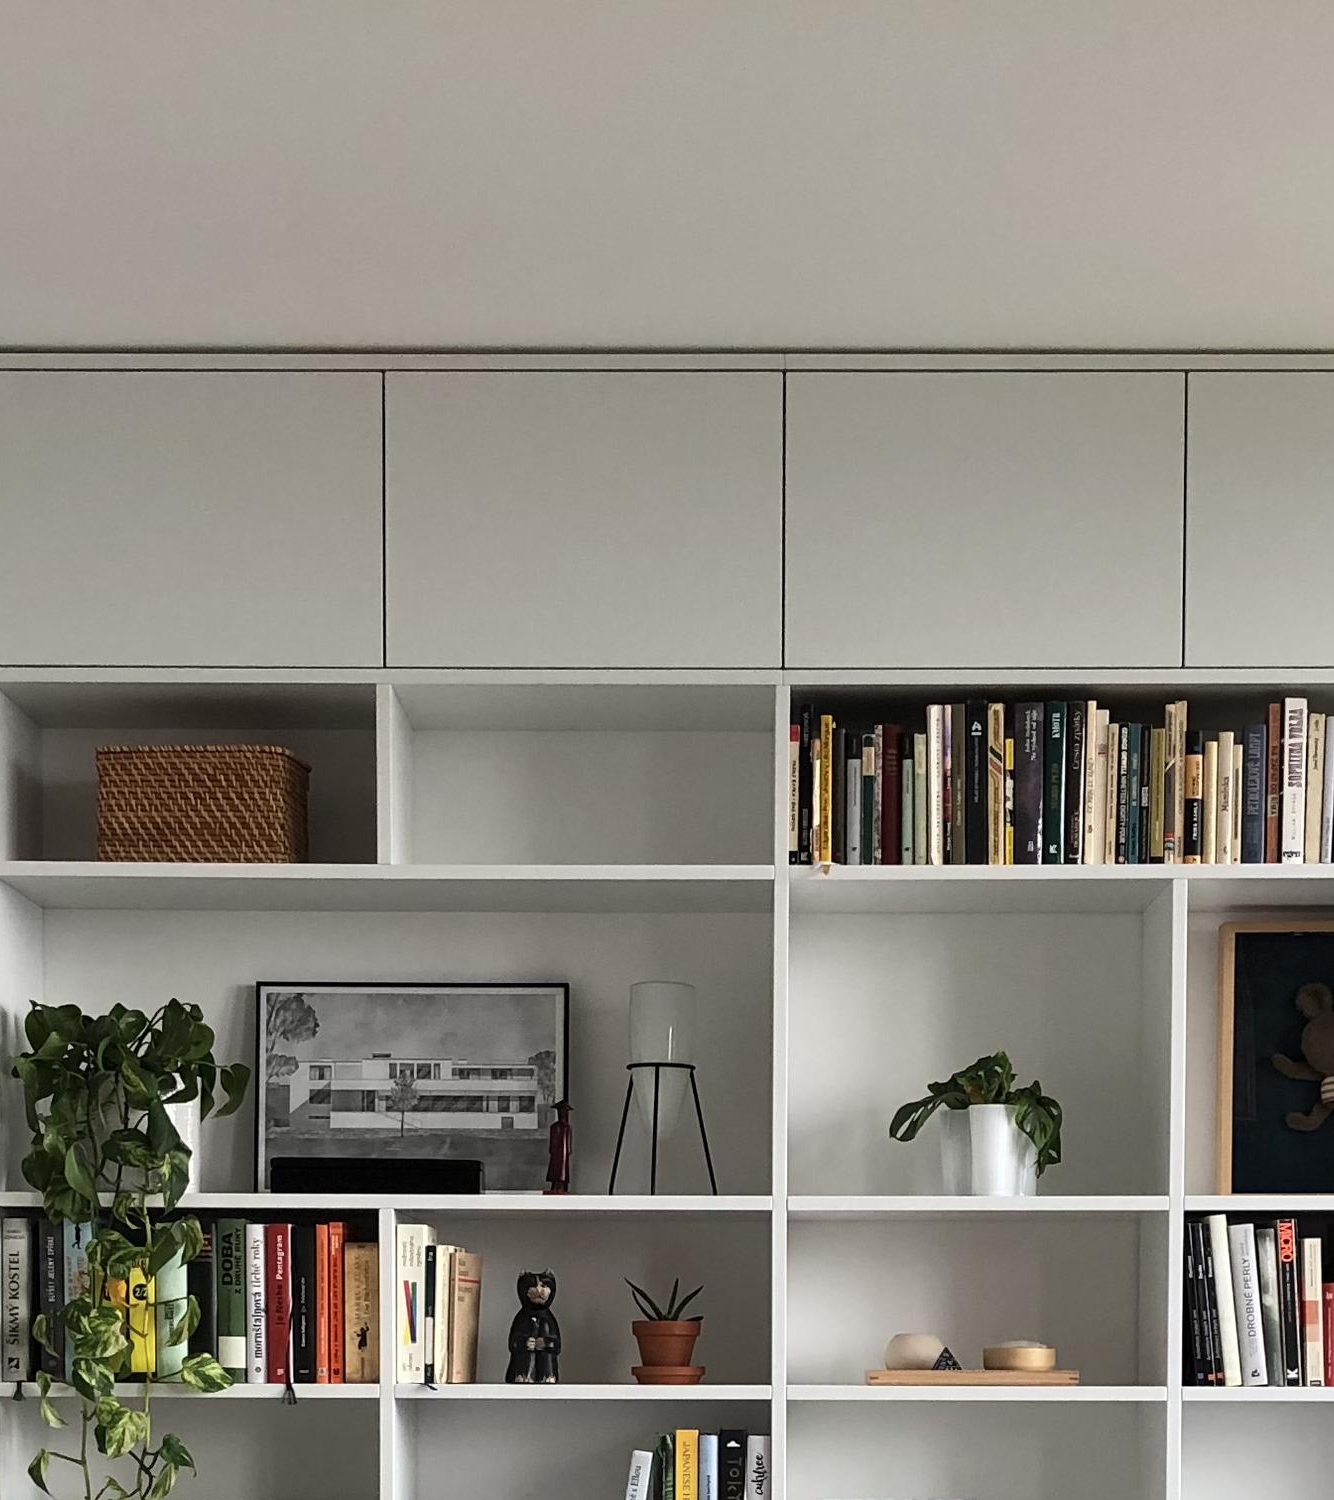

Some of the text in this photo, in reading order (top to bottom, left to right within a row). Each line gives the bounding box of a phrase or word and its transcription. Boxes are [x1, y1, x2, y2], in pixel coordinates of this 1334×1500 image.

[1052, 712, 1060, 738] KMOTR
[1071, 710, 1081, 741] zpátky
[1288, 708, 1303, 788] SOPHIINA VOLBA
[1221, 777, 1229, 812] Maminka
[1247, 733, 1260, 815] PETROLEJOVÉ LAMPY
[221, 1233, 233, 1286] DOBA
[252, 1238, 261, 1261] roky
[275, 1235, 284, 1280] Pentagram
[1279, 1223, 1293, 1262] MICRO
[233, 1255, 241, 1286] DRUHÉ
[6, 1251, 20, 1345] ŠIKMÝ KOSTEL
[1242, 1258, 1256, 1337] DROBNÉ PERLY
[253, 1292, 264, 1358] mornštajnová
[630, 1465, 641, 1486] Ellou
[682, 1441, 691, 1492] JAPANESE
